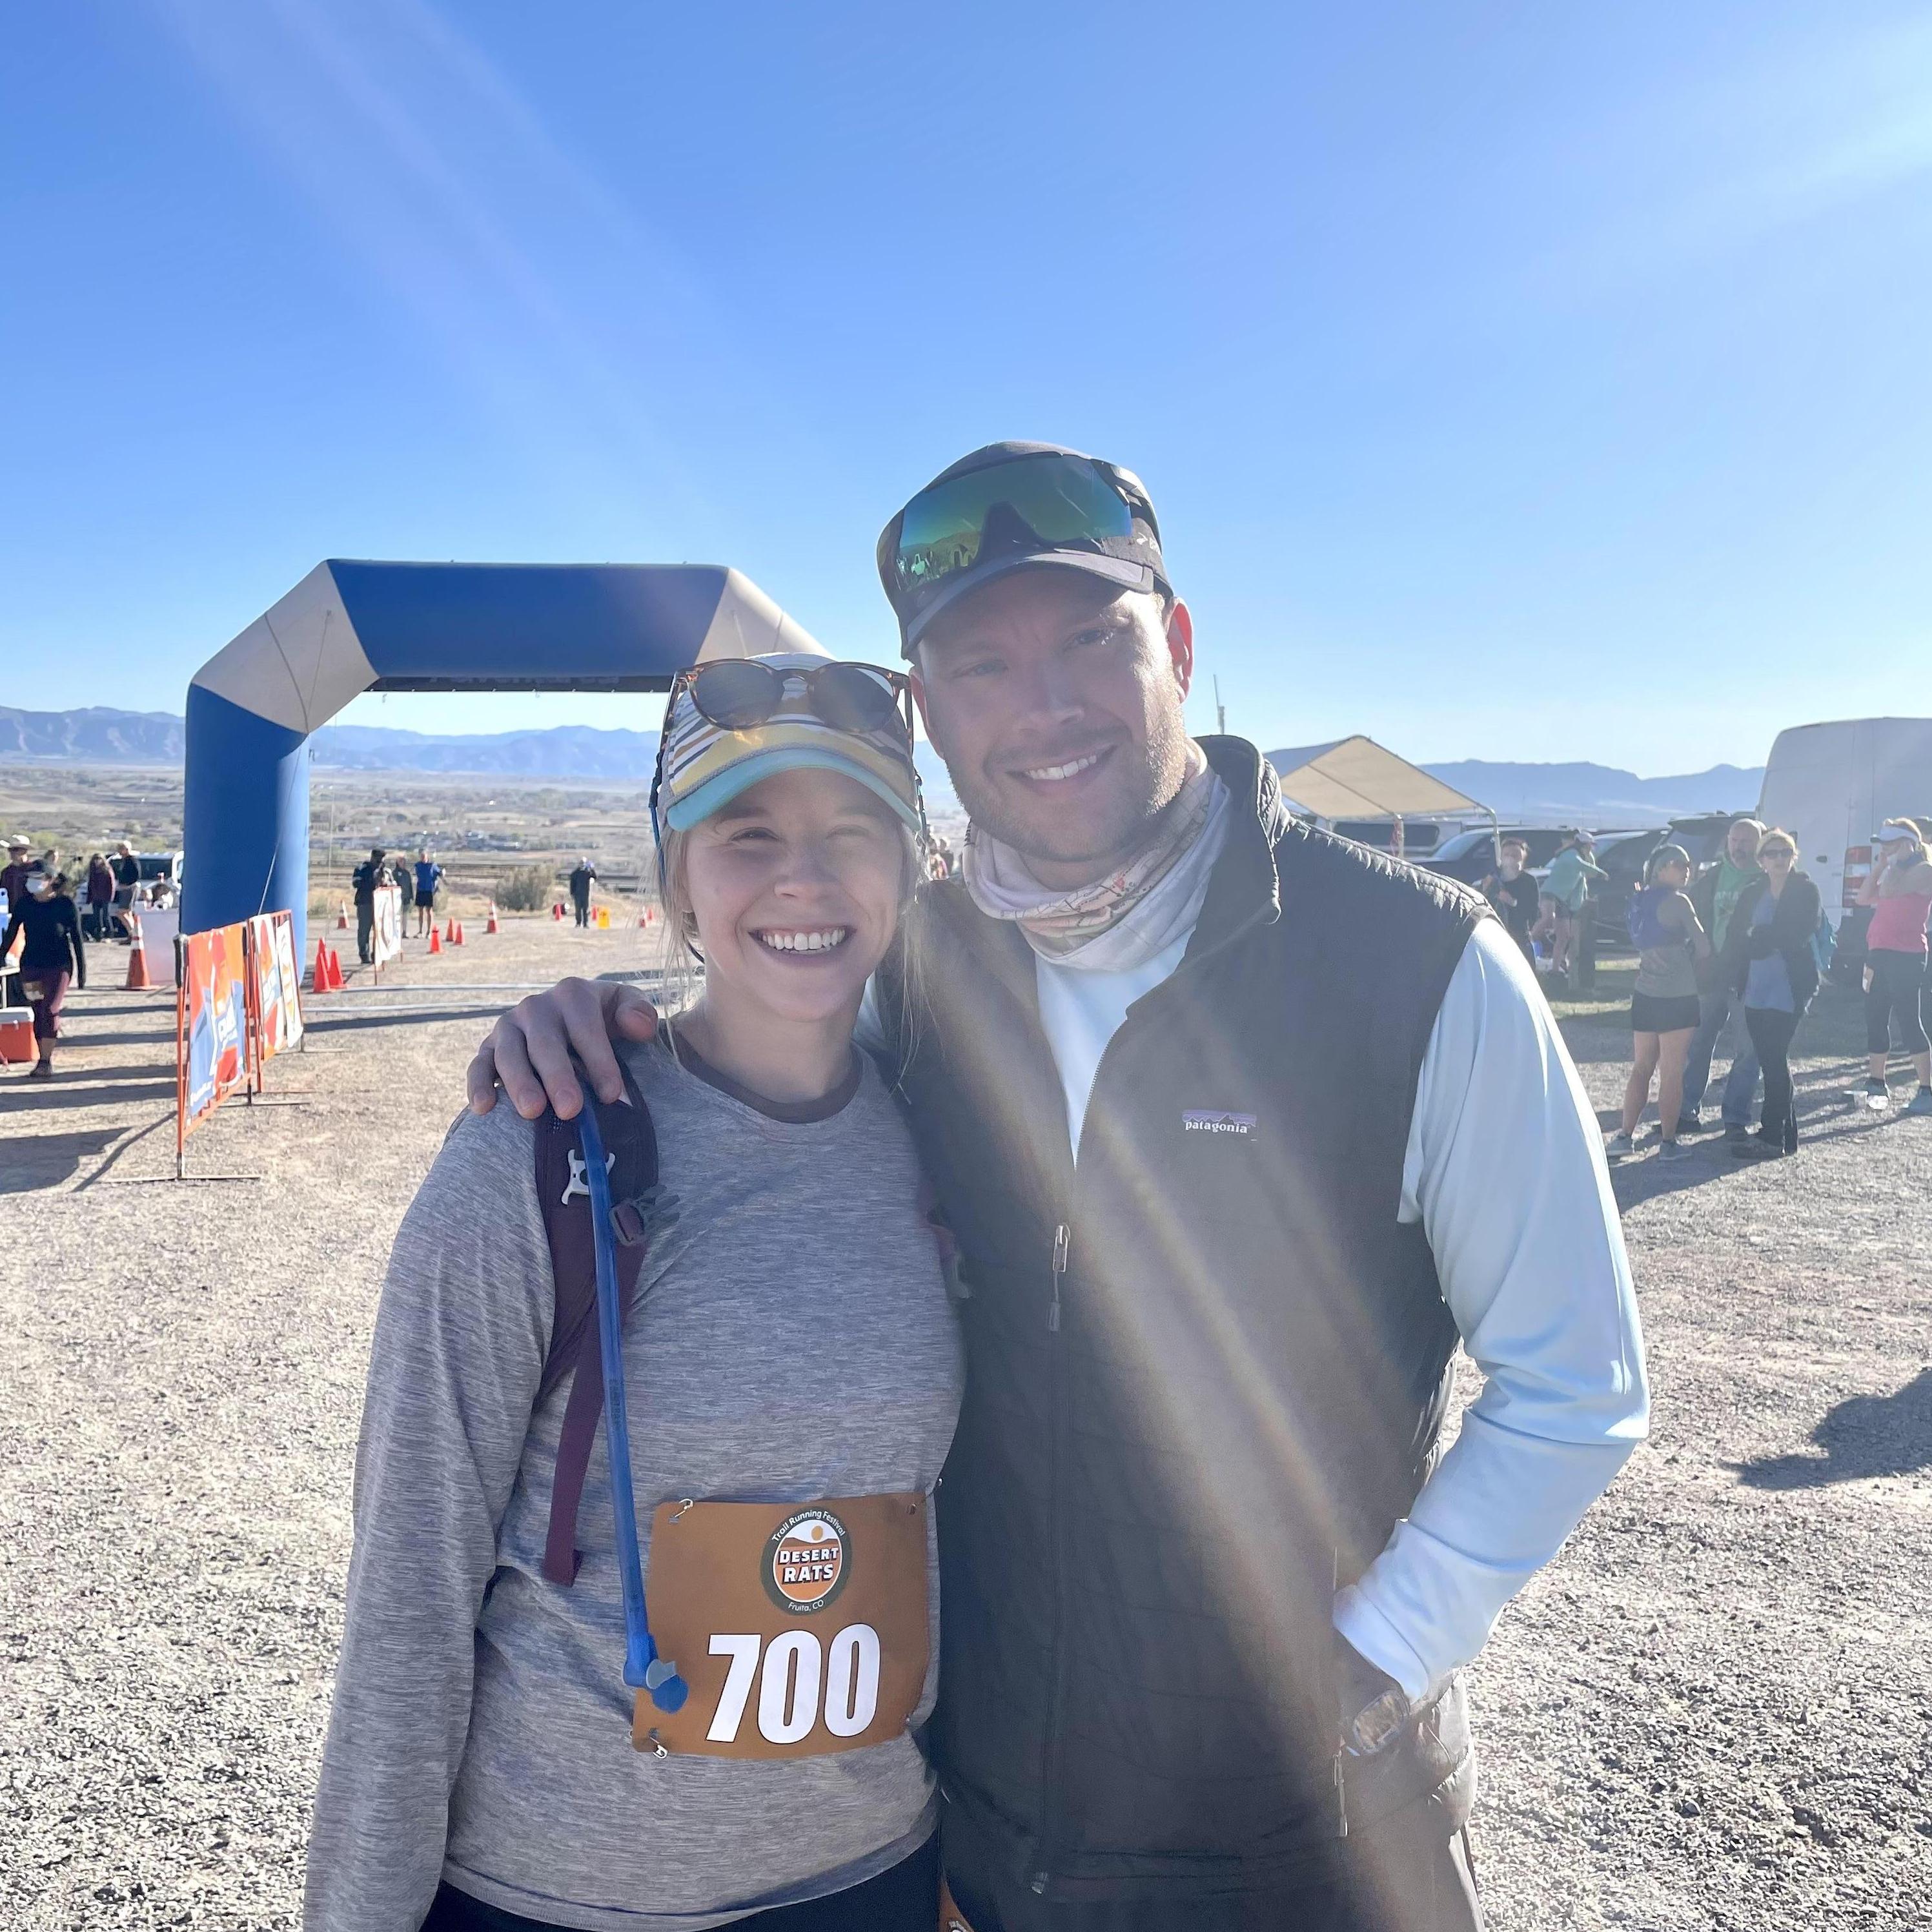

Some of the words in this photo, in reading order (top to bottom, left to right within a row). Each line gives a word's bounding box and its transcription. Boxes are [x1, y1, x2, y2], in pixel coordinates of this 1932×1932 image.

[1185, 1121, 1248, 1134] patagonia
[771, 1522, 789, 1542] Trail
[788, 1509, 822, 1526] Running
[822, 1510, 846, 1537] Festival
[778, 1547, 839, 1565] DESERT
[783, 1563, 834, 1583] RATS
[788, 1602, 811, 1612] Fruita,
[812, 1599, 824, 1610] CO
[706, 1623, 881, 1744] 700
